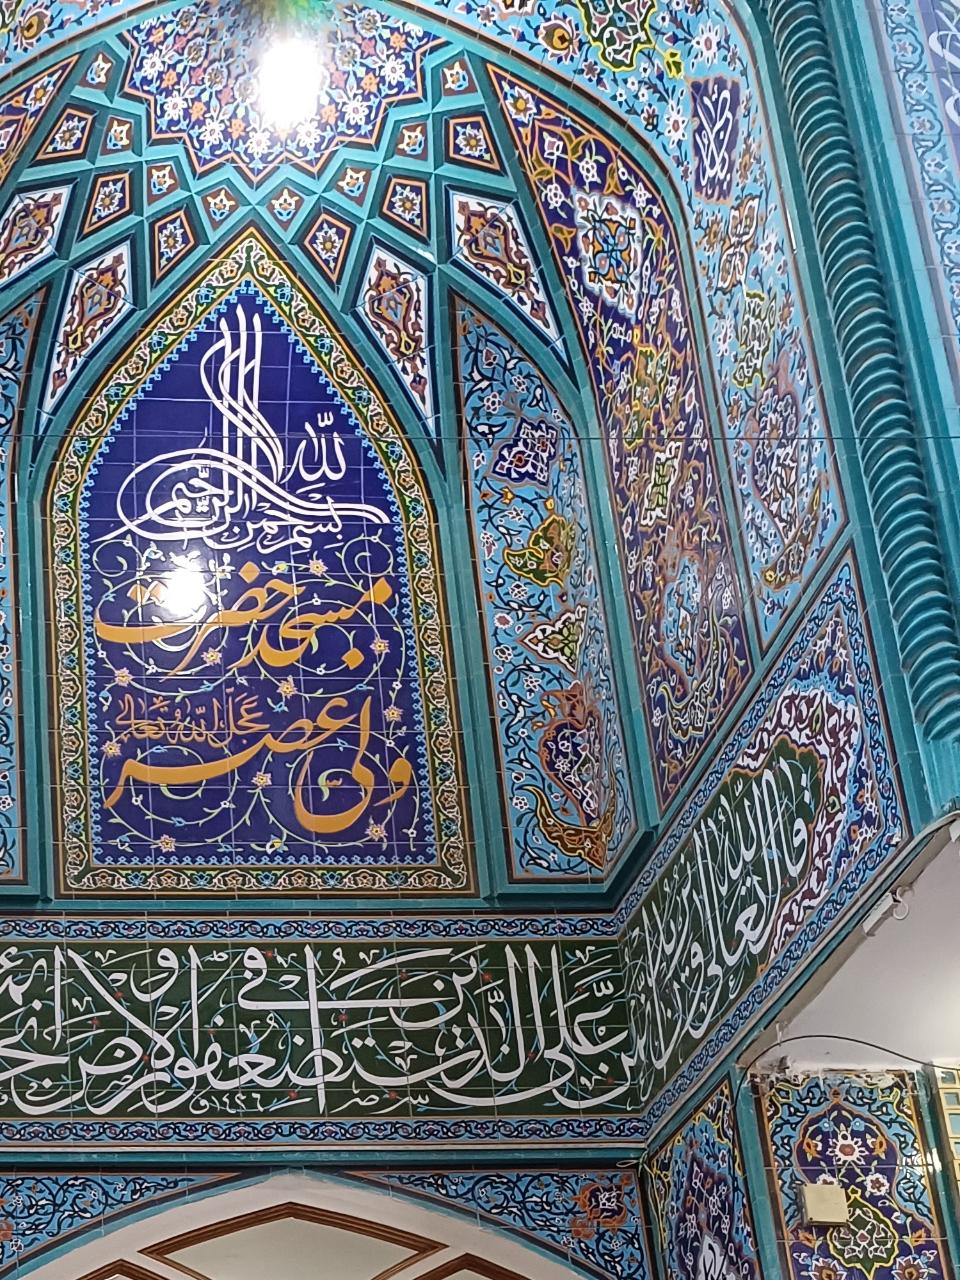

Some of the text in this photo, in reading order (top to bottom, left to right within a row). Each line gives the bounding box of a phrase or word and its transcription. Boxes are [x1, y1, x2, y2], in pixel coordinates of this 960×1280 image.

[94, 561, 393, 683] مسجد حضرت
[102, 696, 359, 809] عصر
